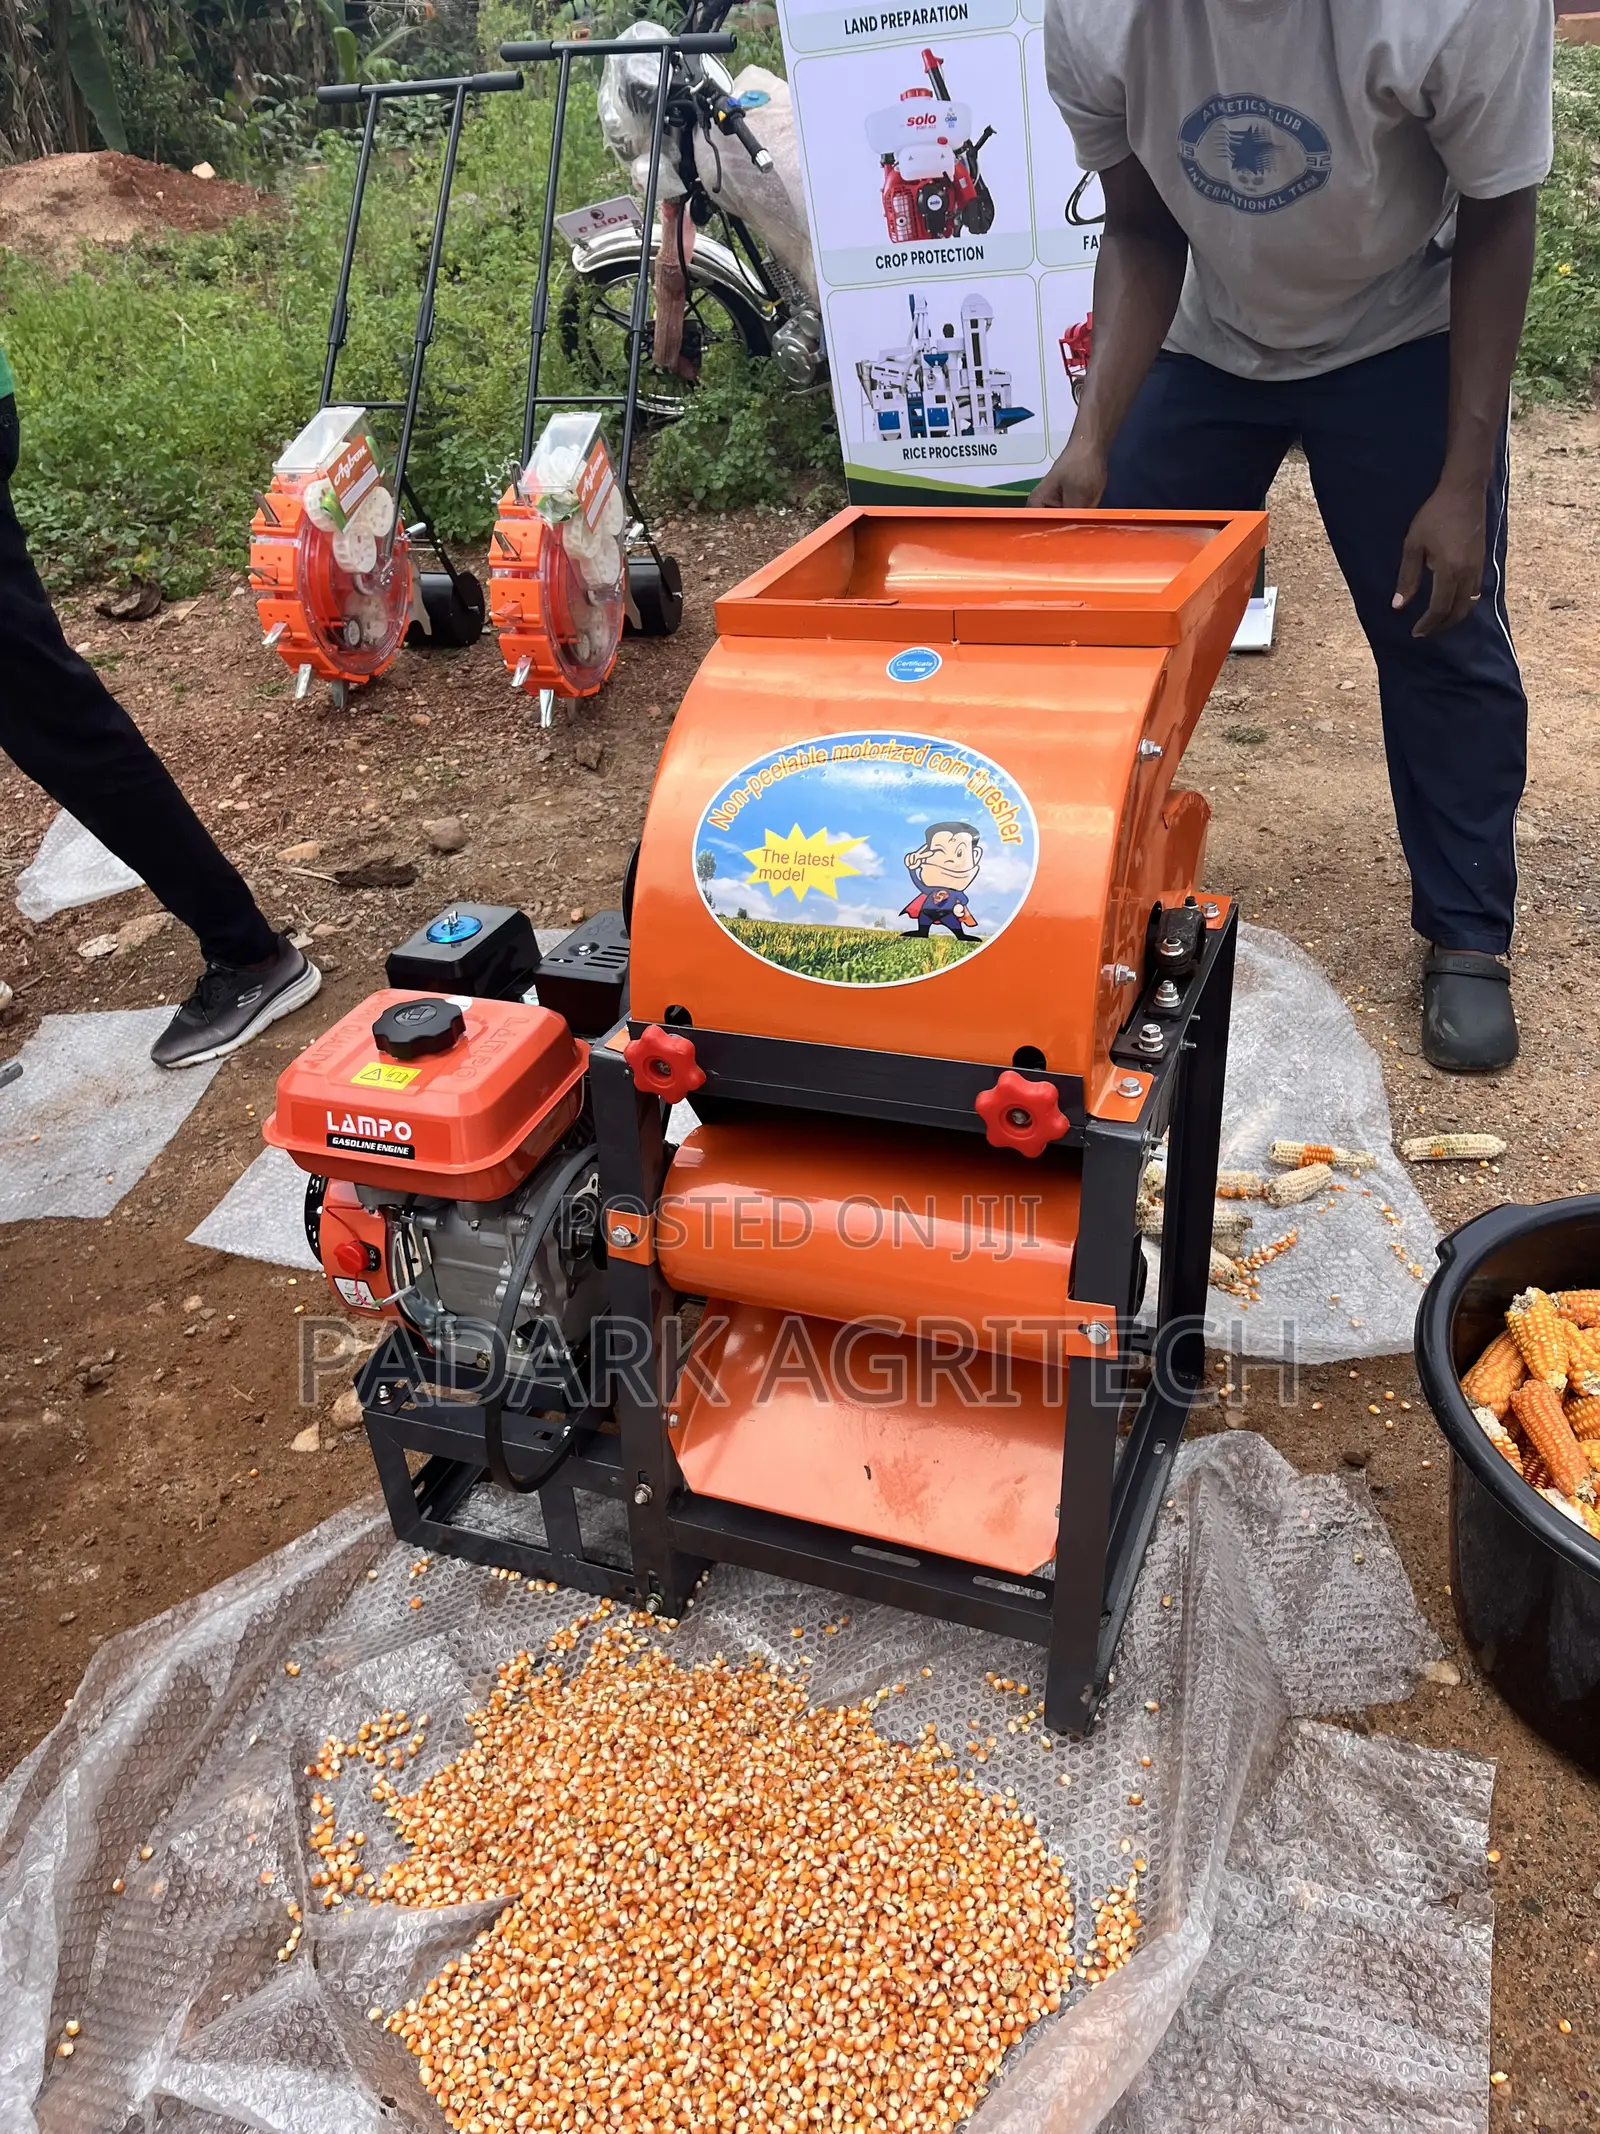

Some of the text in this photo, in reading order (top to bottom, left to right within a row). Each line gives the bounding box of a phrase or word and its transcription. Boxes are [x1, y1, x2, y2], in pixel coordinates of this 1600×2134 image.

[844, 3, 968, 35] LAND PREPARATION
[907, 112, 937, 127] solo
[1268, 108, 1302, 131] CLUB
[1188, 167, 1320, 211] INTERNATIONAL TEAM
[593, 213, 629, 230] LION
[1083, 234, 1102, 251] FA
[875, 245, 984, 270] CROP PROTECTION
[902, 443, 998, 460] RICE PROCESSING
[707, 739, 1024, 845] Non-peelable motorized corn thresher
[762, 849, 836, 868] The latest
[758, 867, 805, 882] model
[326, 1110, 412, 1141] LAMPO
[332, 1136, 410, 1155] GASOLINE ENGINE
